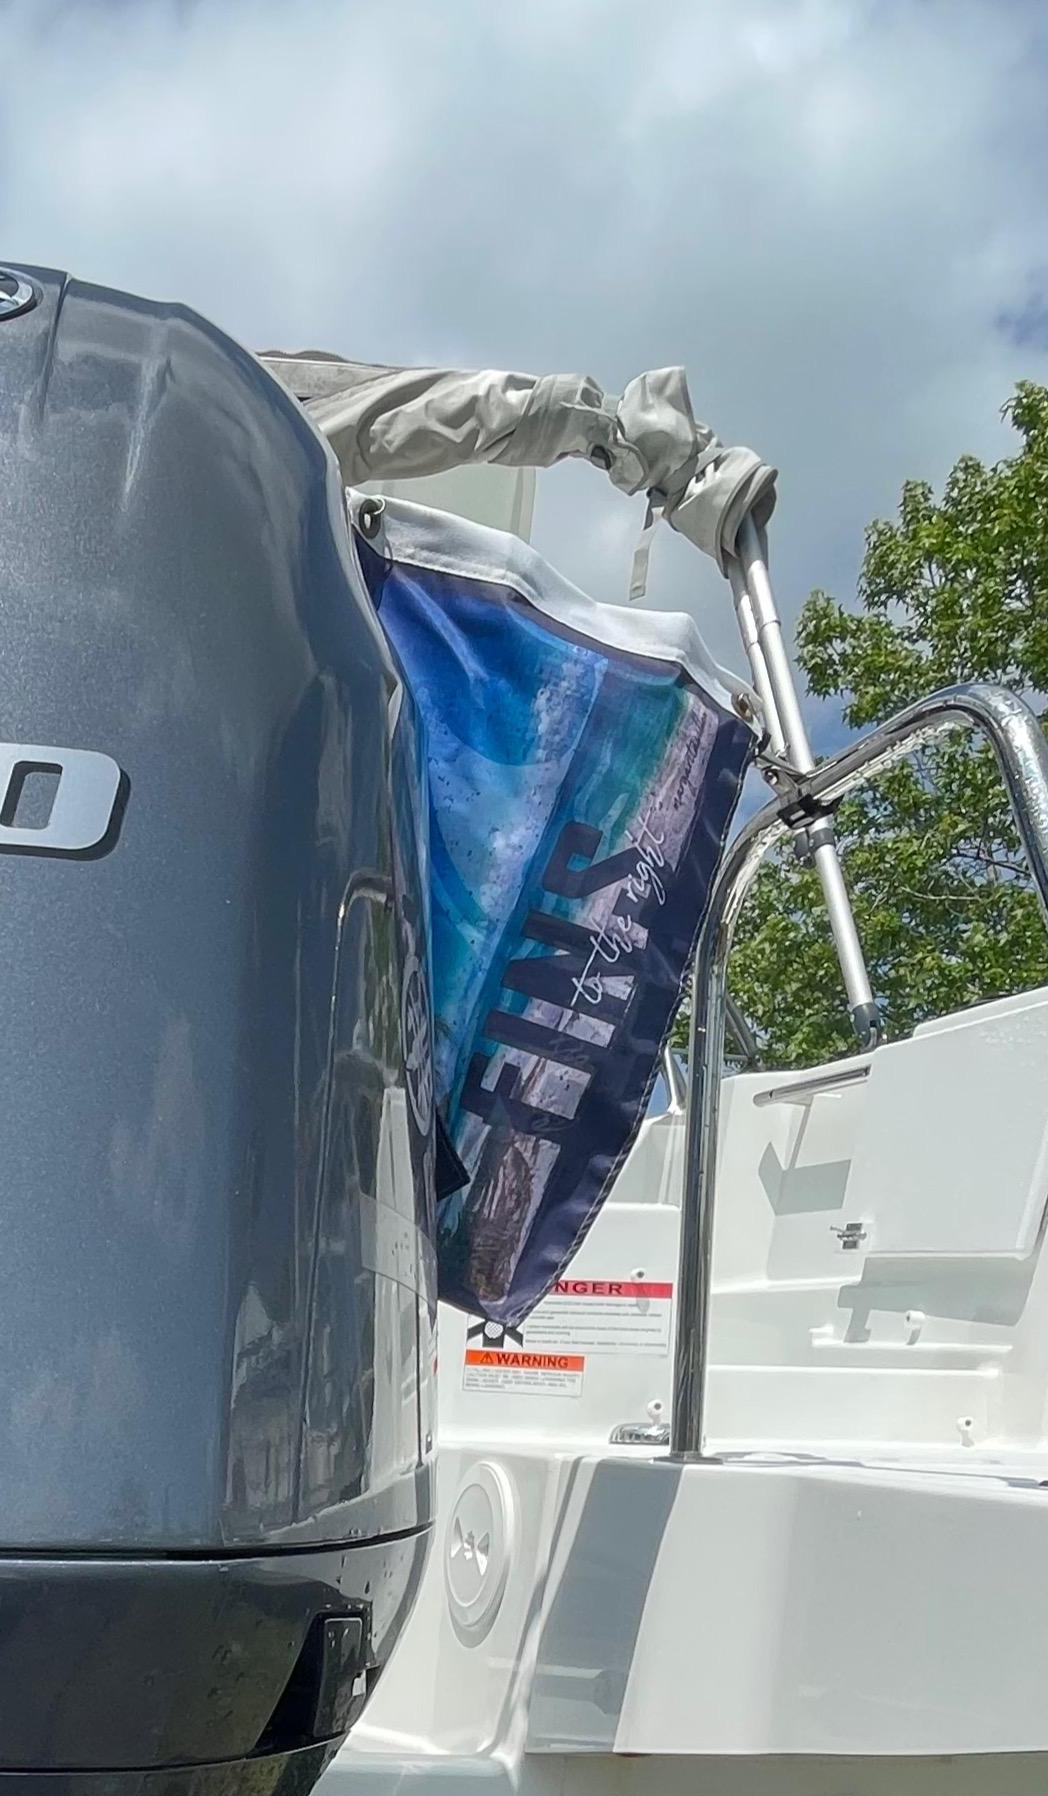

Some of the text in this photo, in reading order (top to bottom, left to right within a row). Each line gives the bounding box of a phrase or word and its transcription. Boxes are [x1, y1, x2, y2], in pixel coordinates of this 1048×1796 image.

[570, 811, 667, 1007] to the right
[461, 820, 649, 1146] FINS
[554, 1280, 623, 1295] NGER
[497, 1352, 569, 1369] WARNING
